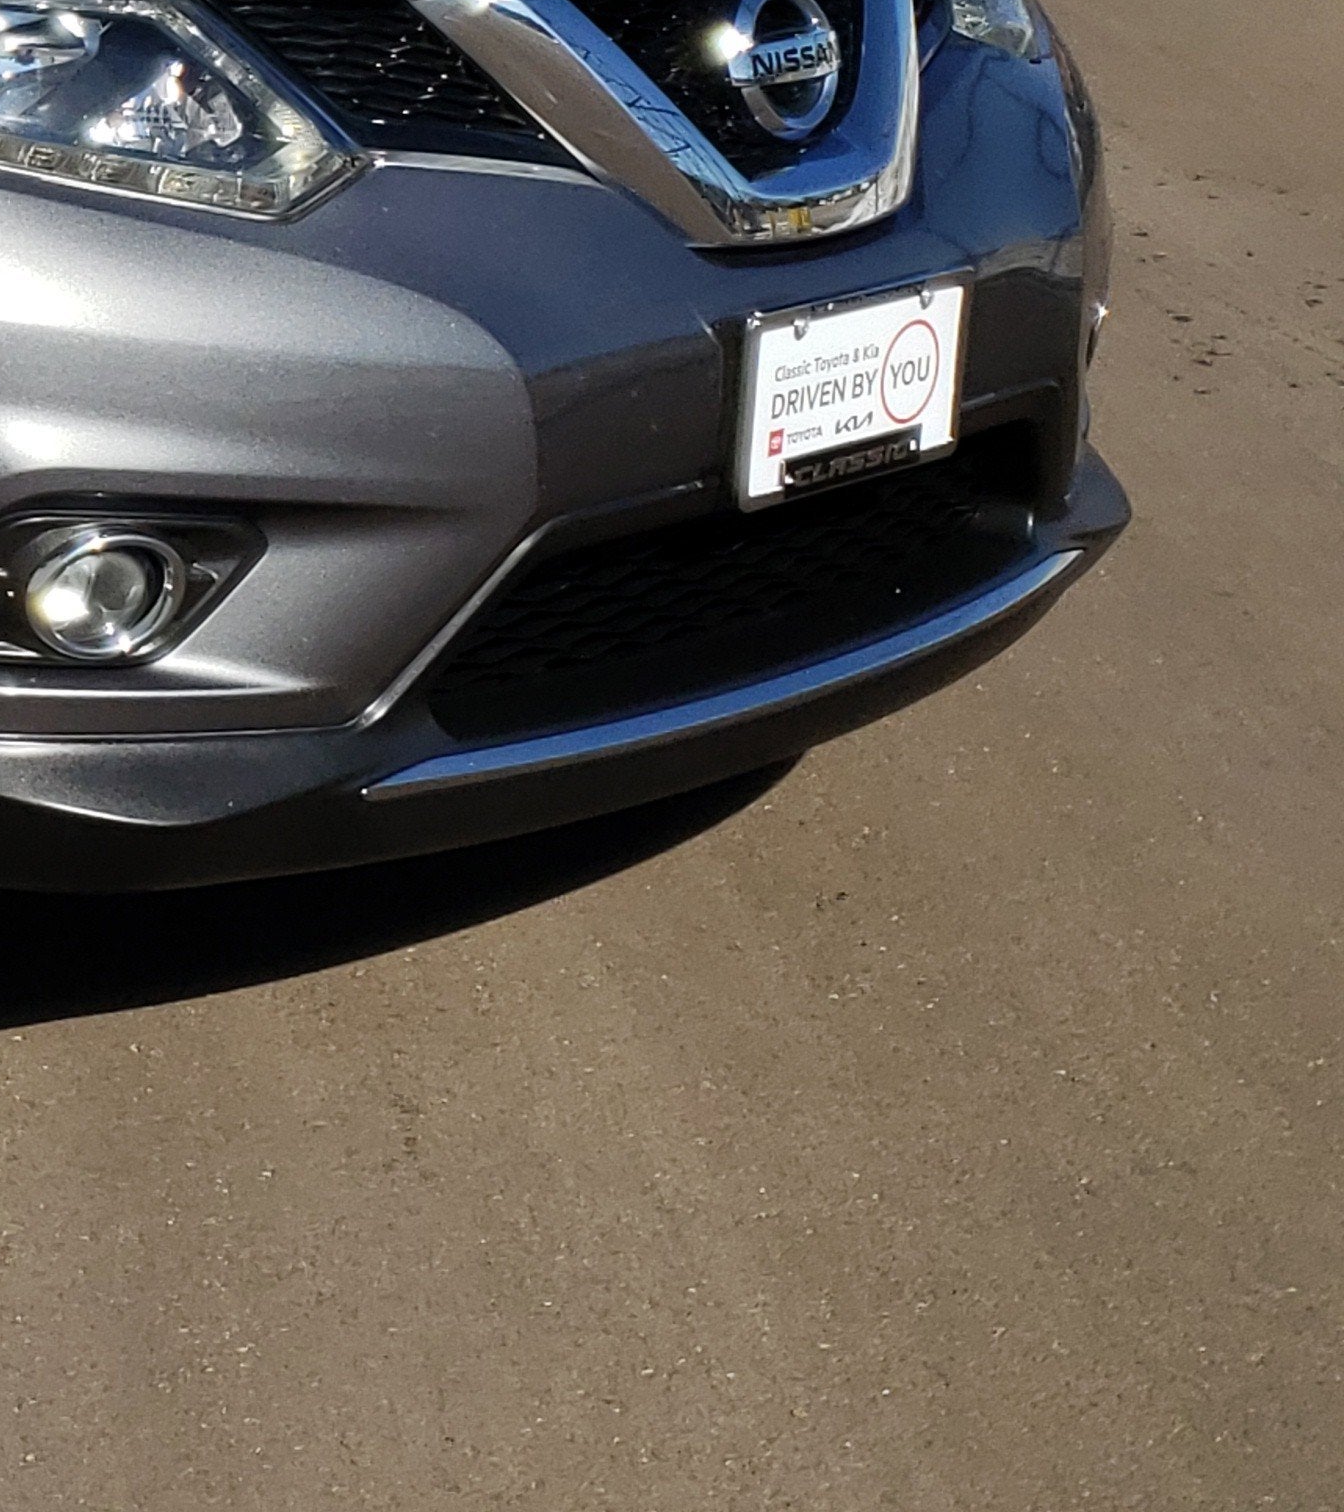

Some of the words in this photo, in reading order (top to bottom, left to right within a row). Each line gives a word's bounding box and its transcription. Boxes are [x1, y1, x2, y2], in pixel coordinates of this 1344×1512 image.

[751, 41, 837, 77] NISSAN
[775, 359, 811, 382] Classic
[814, 353, 849, 372] Toyota
[863, 344, 879, 360] Kia
[771, 376, 847, 420] DRIVEN
[852, 368, 879, 399] BY
[890, 356, 930, 389] YOU
[787, 426, 823, 445] TOYOTA
[795, 439, 909, 486] CLASSIC
